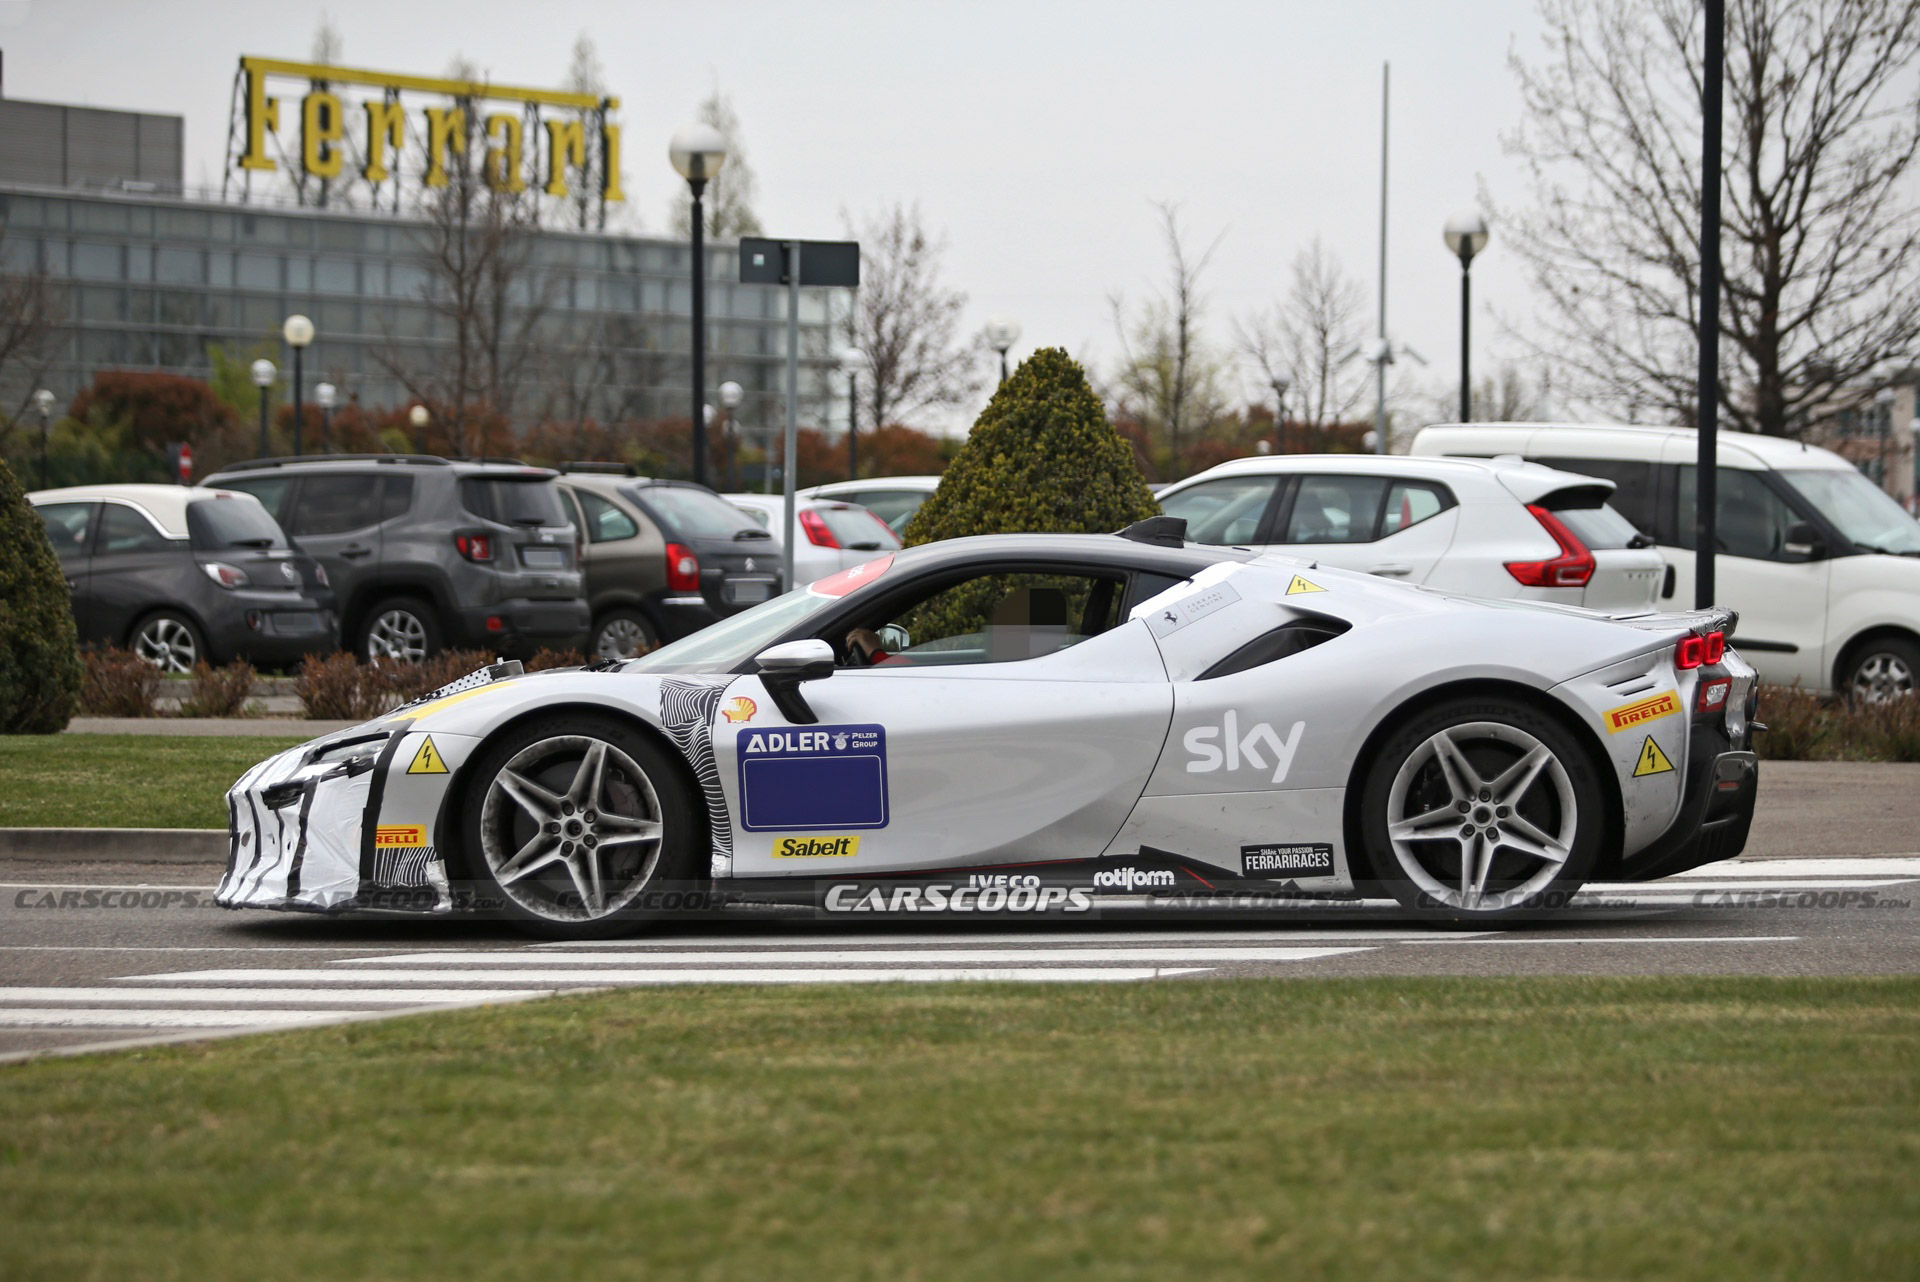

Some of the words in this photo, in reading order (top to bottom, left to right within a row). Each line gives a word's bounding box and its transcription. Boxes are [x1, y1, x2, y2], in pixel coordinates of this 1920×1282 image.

[239, 56, 626, 201] Ferrari
[1187, 591, 1220, 609] FERRARI
[1190, 596, 1224, 613] GENUINE
[1611, 696, 1673, 728] PIRELLI
[745, 732, 830, 753] ADLER
[1183, 709, 1306, 783] sky
[780, 838, 851, 857] Sabelt
[1291, 846, 1314, 854] PASSION
[1245, 852, 1330, 870] FERRARIRACES
[969, 874, 1041, 888] IVECO
[1093, 866, 1175, 892] rotiform
